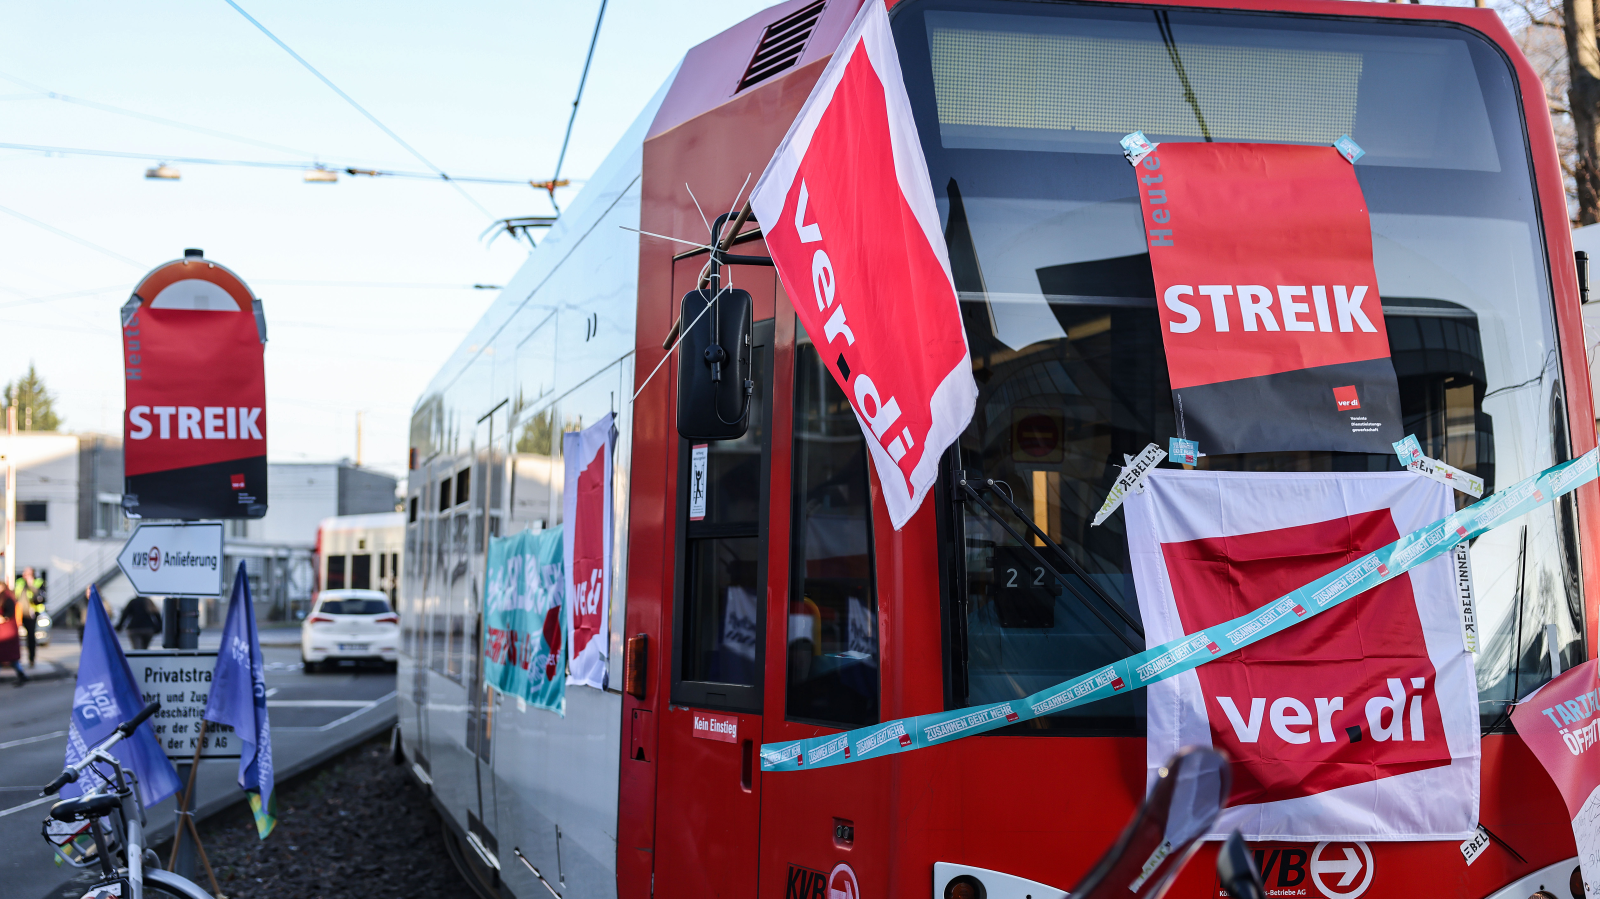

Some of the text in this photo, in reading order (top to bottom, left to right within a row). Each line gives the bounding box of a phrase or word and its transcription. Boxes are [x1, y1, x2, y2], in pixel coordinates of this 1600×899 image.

[1163, 284, 1378, 334] STREIK
[129, 405, 263, 440] STREIK
[1504, 491, 1522, 508] GEHT
[1426, 527, 1446, 545] GEHT
[163, 551, 217, 571] Anlieferung
[1313, 578, 1349, 605] ZUSAMMEN
[1345, 567, 1364, 584] GEHT
[1361, 556, 1382, 573] MEHR
[1227, 598, 1297, 644] ZUSAMMEN GEHT MEHR
[1137, 634, 1211, 680] ZUSAMMEN GEHT MEHR
[145, 667, 212, 683] Privatstra
[1032, 669, 1118, 714] ZUSAMMEN GEHT MEHR
[142, 691, 208, 703] ahrt und Zug
[1216, 677, 1426, 744] ver.di
[172, 723, 188, 733] der
[694, 716, 737, 738] Kein Einstieg
[925, 705, 1014, 740] ZUSAMMEN GEHT MEHR
[168, 738, 184, 749] der
[215, 737, 228, 748] AG
[1250, 848, 1308, 887] VB
